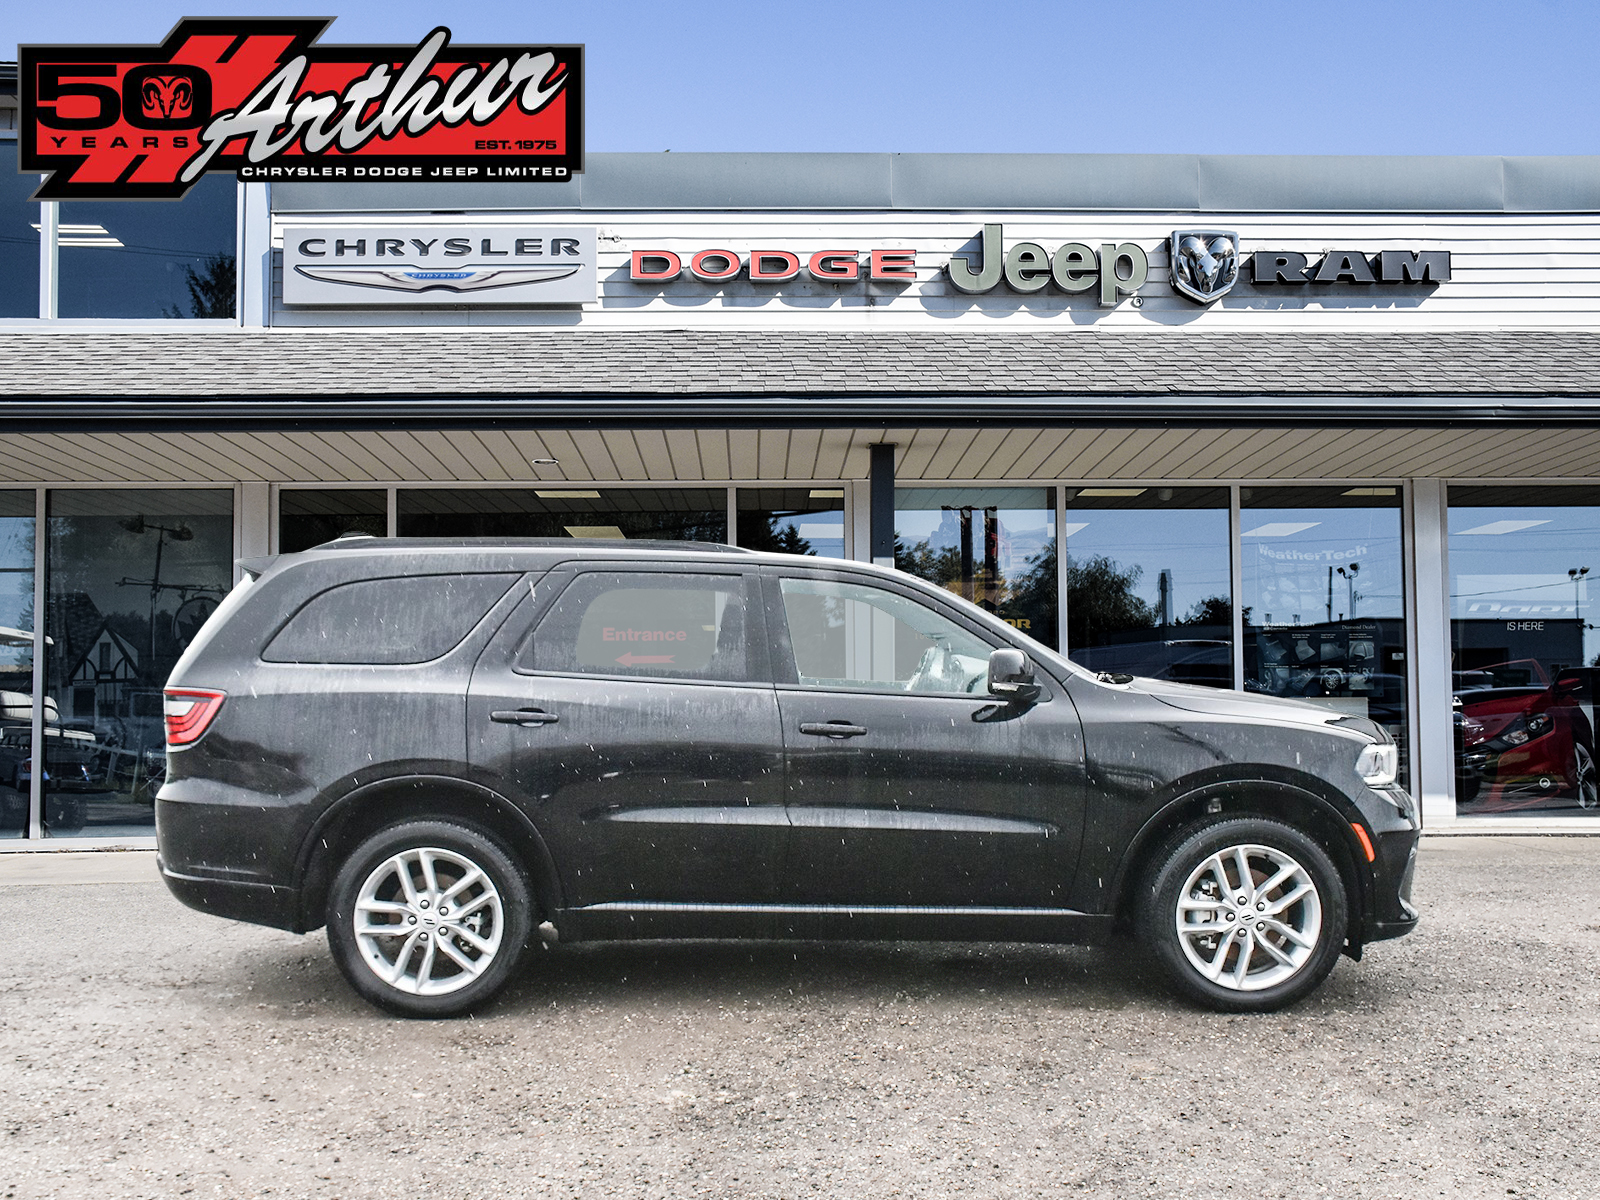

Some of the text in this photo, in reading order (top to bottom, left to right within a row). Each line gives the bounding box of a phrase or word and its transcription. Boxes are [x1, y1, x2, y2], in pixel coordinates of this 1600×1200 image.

[299, 238, 582, 258] CHRYSLER
[629, 249, 918, 284] DODGE
[948, 223, 1149, 307] Jeep
[1250, 250, 1451, 286] RAM
[1258, 543, 1367, 561] WeatherTech
[602, 627, 687, 641] Entrance
[1506, 621, 1544, 631] IS HERE
